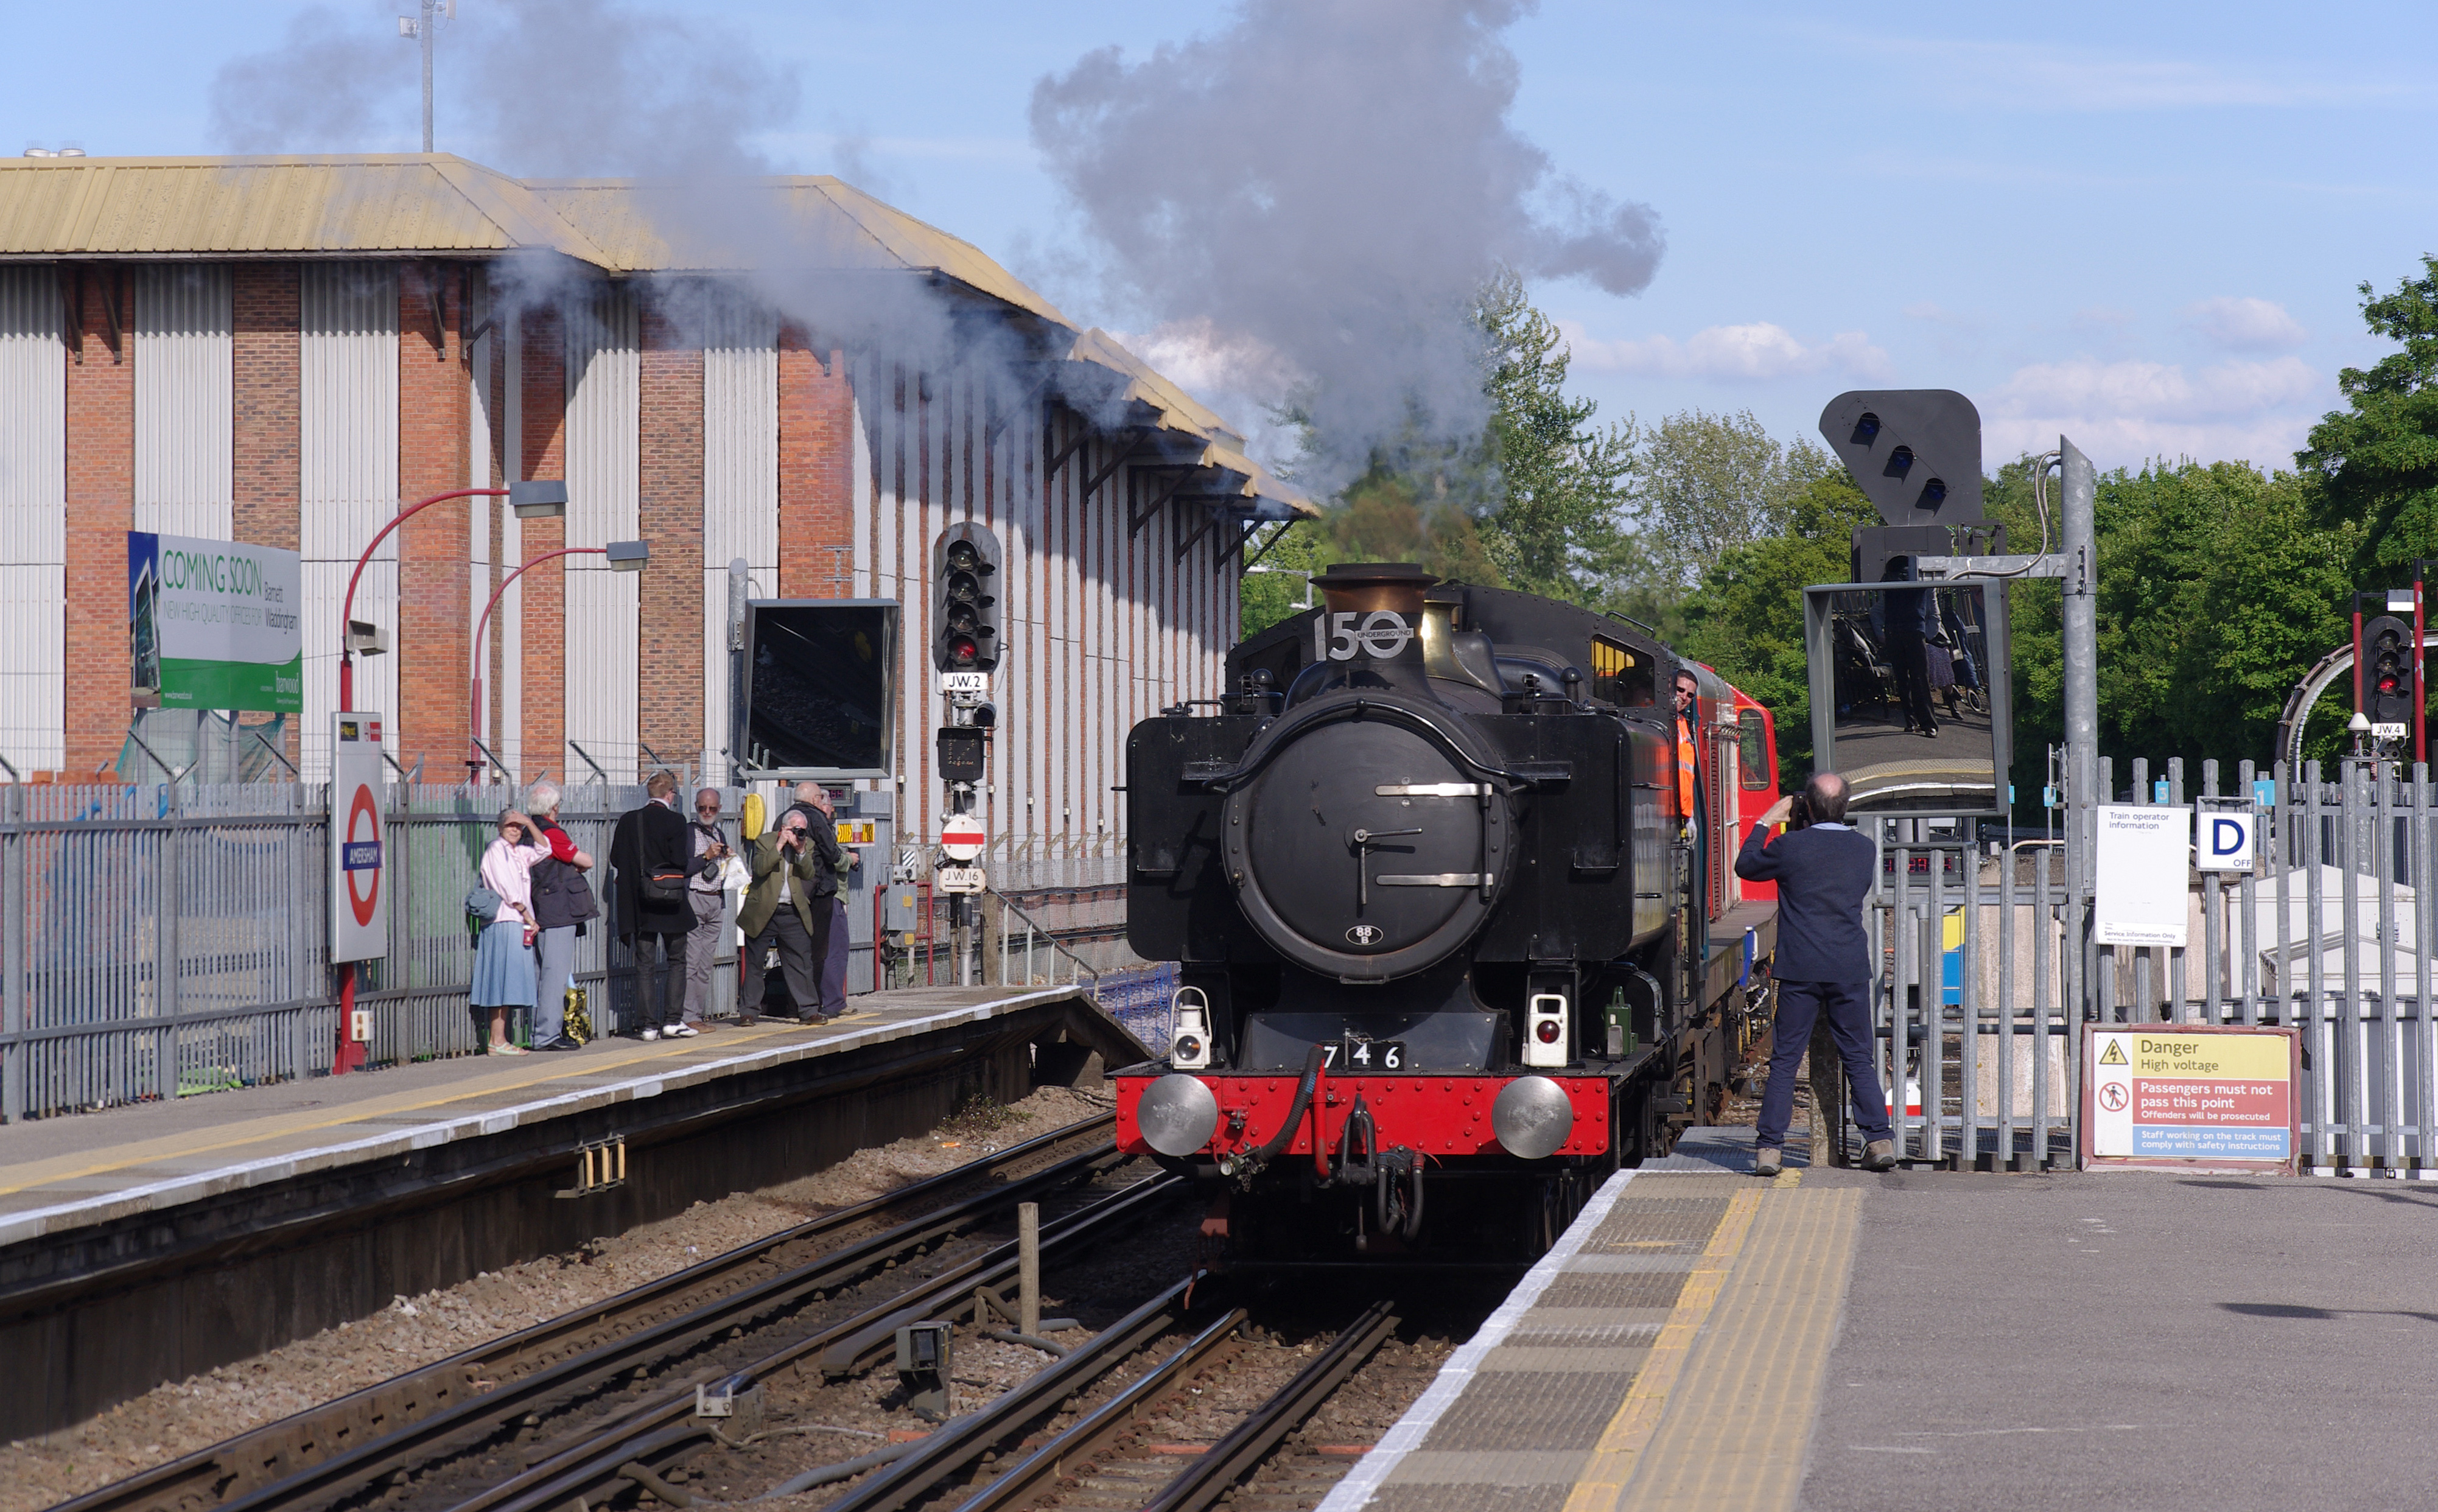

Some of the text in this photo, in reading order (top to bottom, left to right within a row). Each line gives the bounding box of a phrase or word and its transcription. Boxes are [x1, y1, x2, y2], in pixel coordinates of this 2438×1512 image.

[163, 550, 262, 597] COMING SOON
[164, 601, 181, 620] NEW
[182, 602, 200, 621] HIGH
[201, 603, 230, 625] QUALITY
[1356, 629, 1411, 639] UNDERGROUND
[949, 676, 981, 687] JW.2
[2377, 725, 2400, 734] JW.4
[2109, 811, 2170, 822] Train operator
[2109, 821, 2159, 830] information
[2212, 818, 2245, 856] D
[349, 847, 377, 864] AMERSHAM
[2233, 859, 2252, 867] OFF
[945, 870, 979, 881] JW.16
[1356, 926, 1373, 937] 88
[2140, 1039, 2199, 1057] Danger
[2140, 1059, 2219, 1073] High voltage
[2140, 1082, 2273, 1096] Passengers must not
[2140, 1097, 2235, 1110] pass this point
[2141, 1111, 2271, 1122] Offenders will be prosecuted
[2142, 1130, 2164, 1139] Staff
[2167, 1131, 2201, 1141] working
[2234, 1132, 2256, 1141] track
[2141, 1140, 2280, 1151] comply with safety instructions
